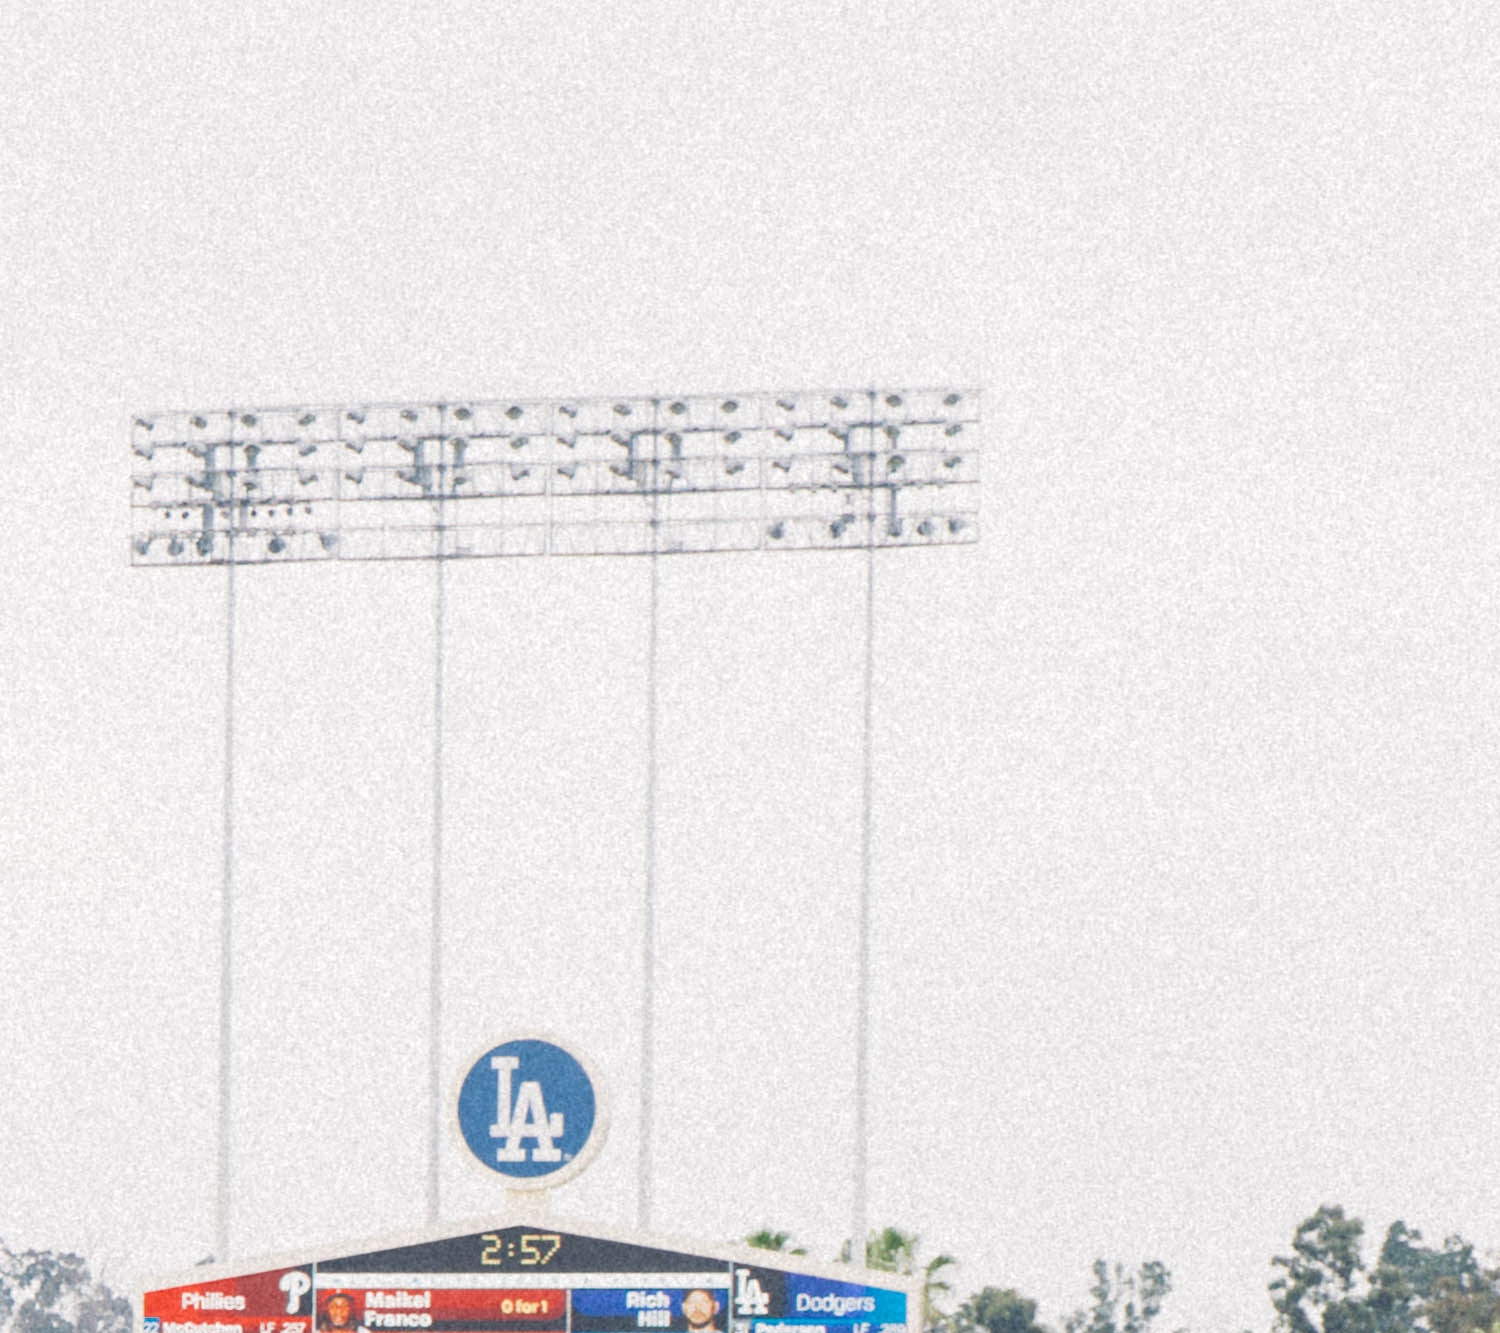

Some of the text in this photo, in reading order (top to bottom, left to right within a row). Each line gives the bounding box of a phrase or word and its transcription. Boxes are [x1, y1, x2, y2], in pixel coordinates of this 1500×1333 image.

[489, 1056, 564, 1162] LA
[482, 1234, 561, 1265] 2:57
[181, 1292, 246, 1310] Phillies
[364, 1291, 431, 1308] Maikel
[626, 1291, 670, 1308] Rich
[796, 1293, 876, 1316] Dodgers
[364, 1311, 432, 1327] Franco
[637, 1310, 671, 1327] Hill
